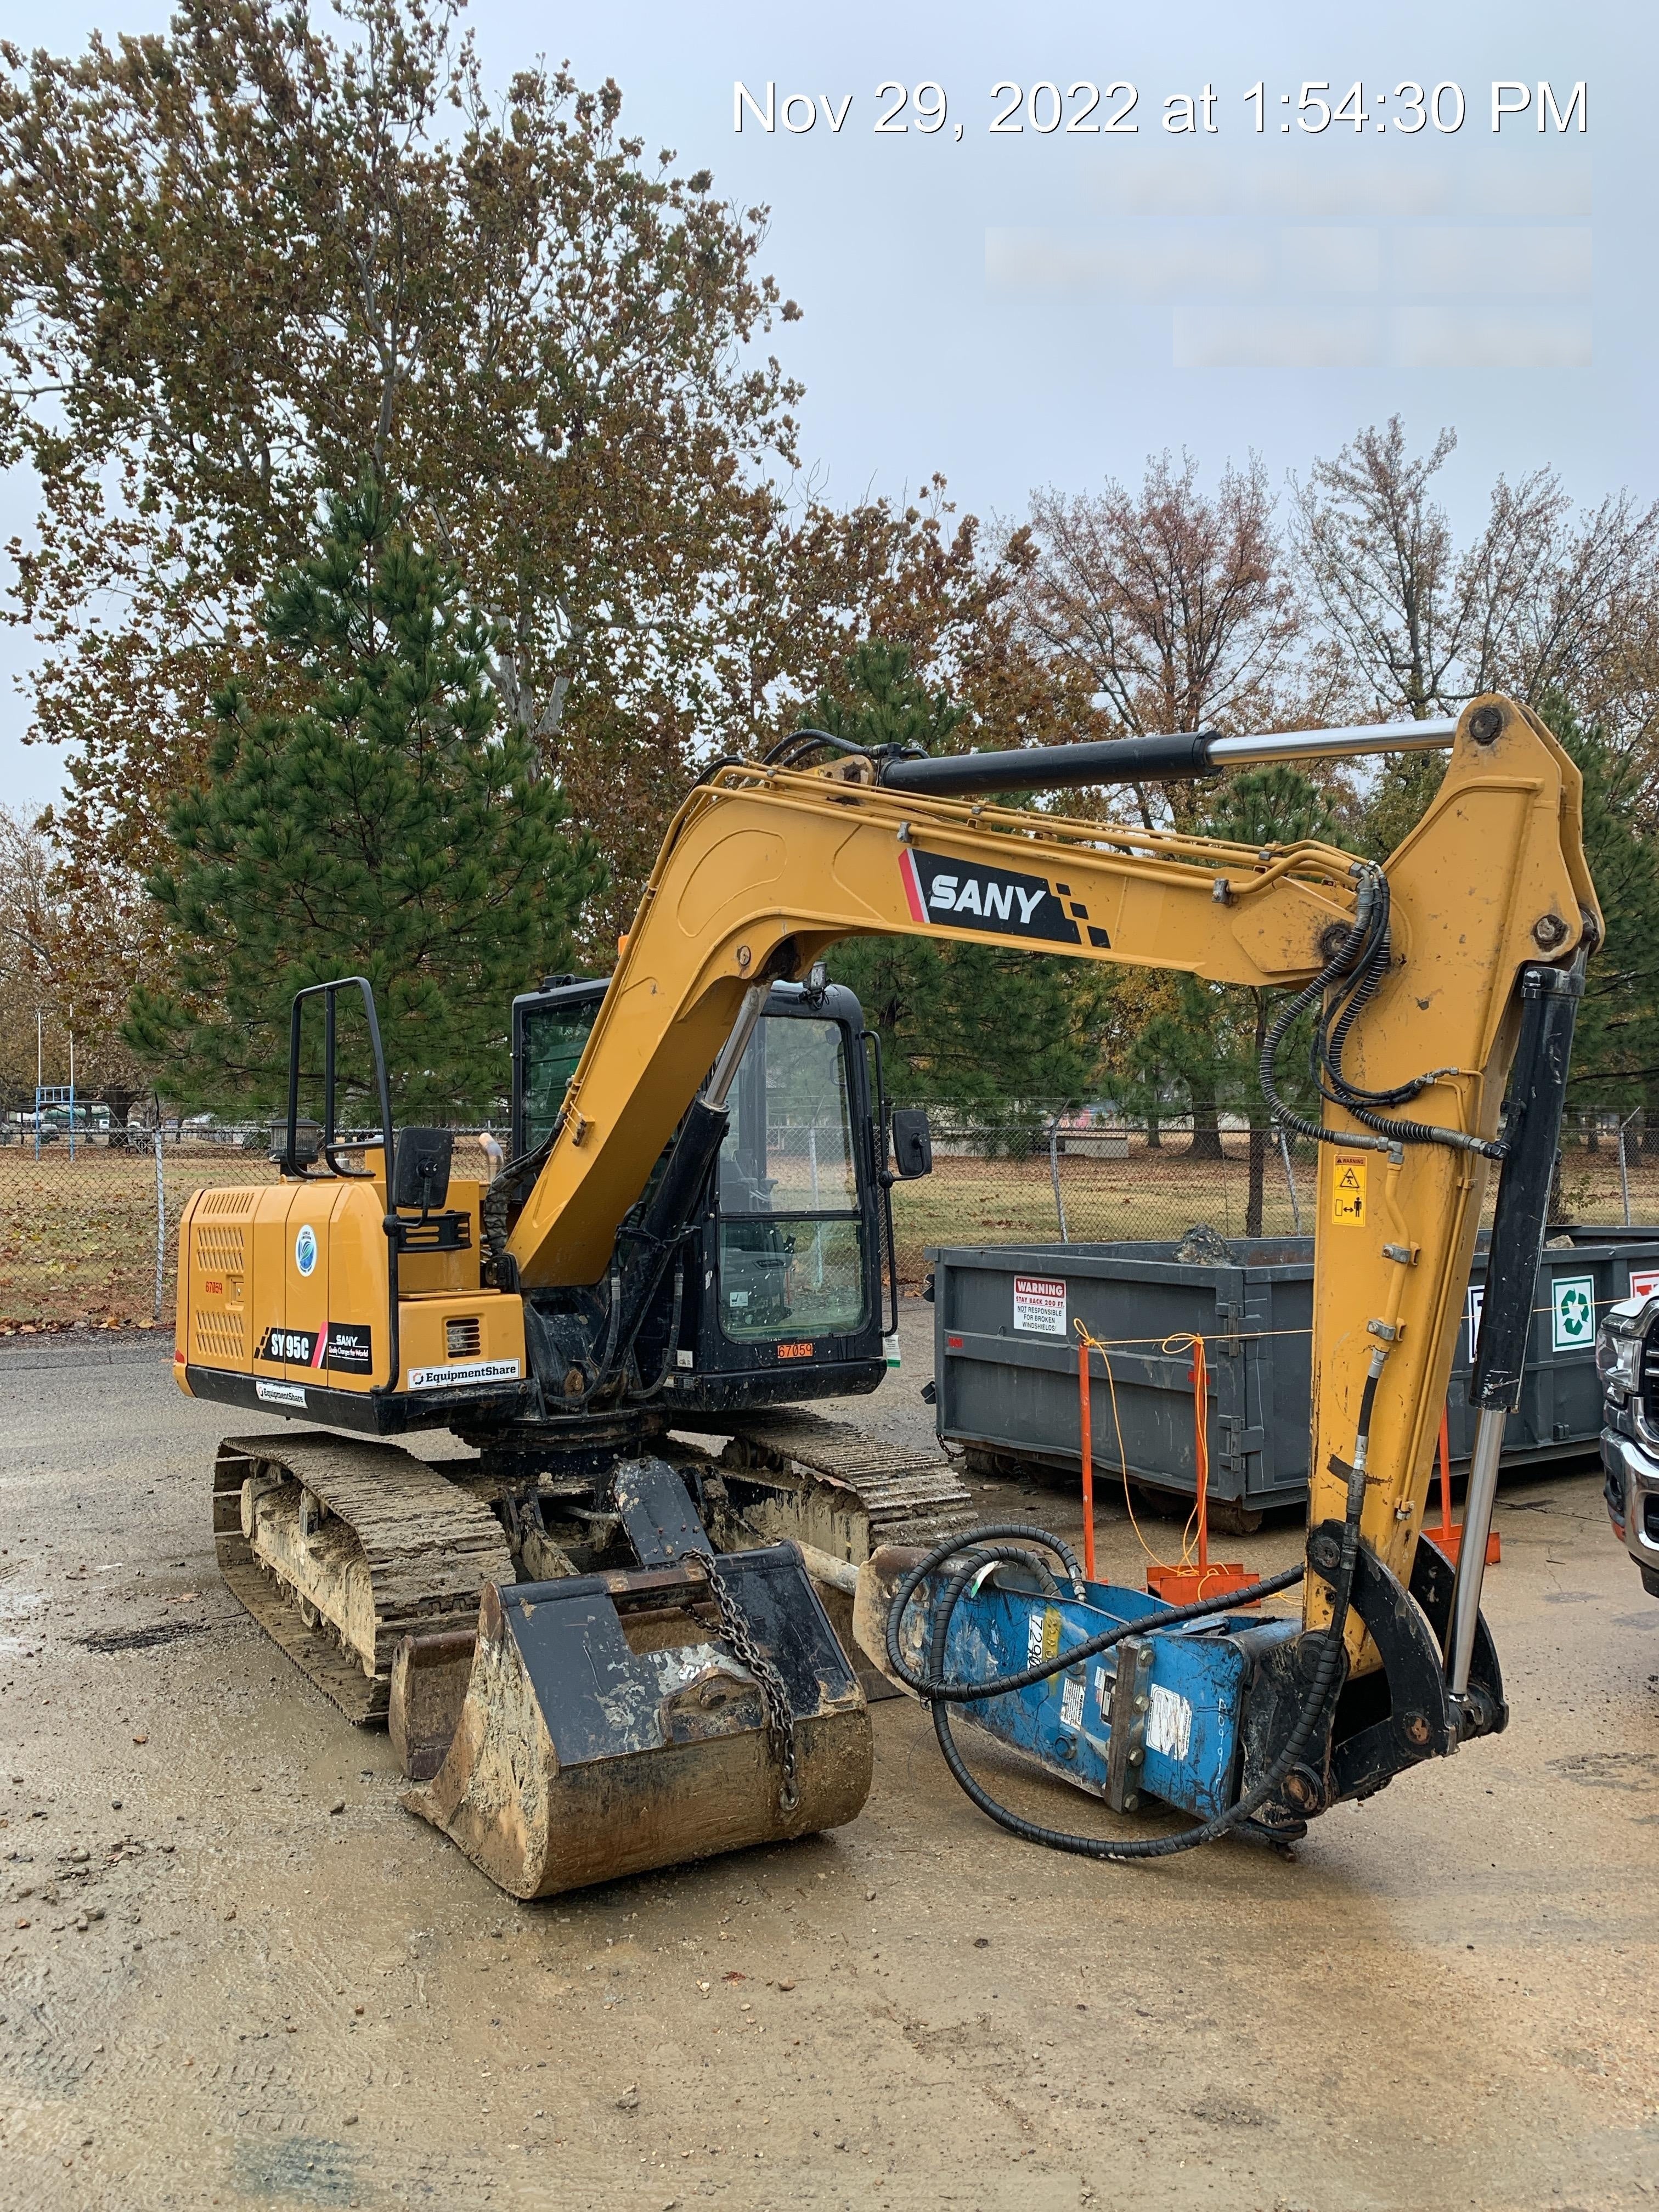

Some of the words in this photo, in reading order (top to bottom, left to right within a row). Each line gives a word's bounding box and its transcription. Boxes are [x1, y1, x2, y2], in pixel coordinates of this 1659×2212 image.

[929, 874, 1047, 924] SANY
[205, 1280, 223, 1295] 67059
[1017, 1280, 1063, 1296] WARNING
[1028, 1306, 1062, 1317] RESPONSIBLE
[1035, 1315, 1056, 1323] BROKEN
[1022, 1321, 1057, 1331] WINDSHIELDS!
[336, 1334, 358, 1347] SANY
[355, 1349, 369, 1357] World
[778, 1344, 812, 1357] 67059
[426, 1366, 516, 1383] EquipmentShare
[263, 1388, 304, 1403] EquipmentShare
